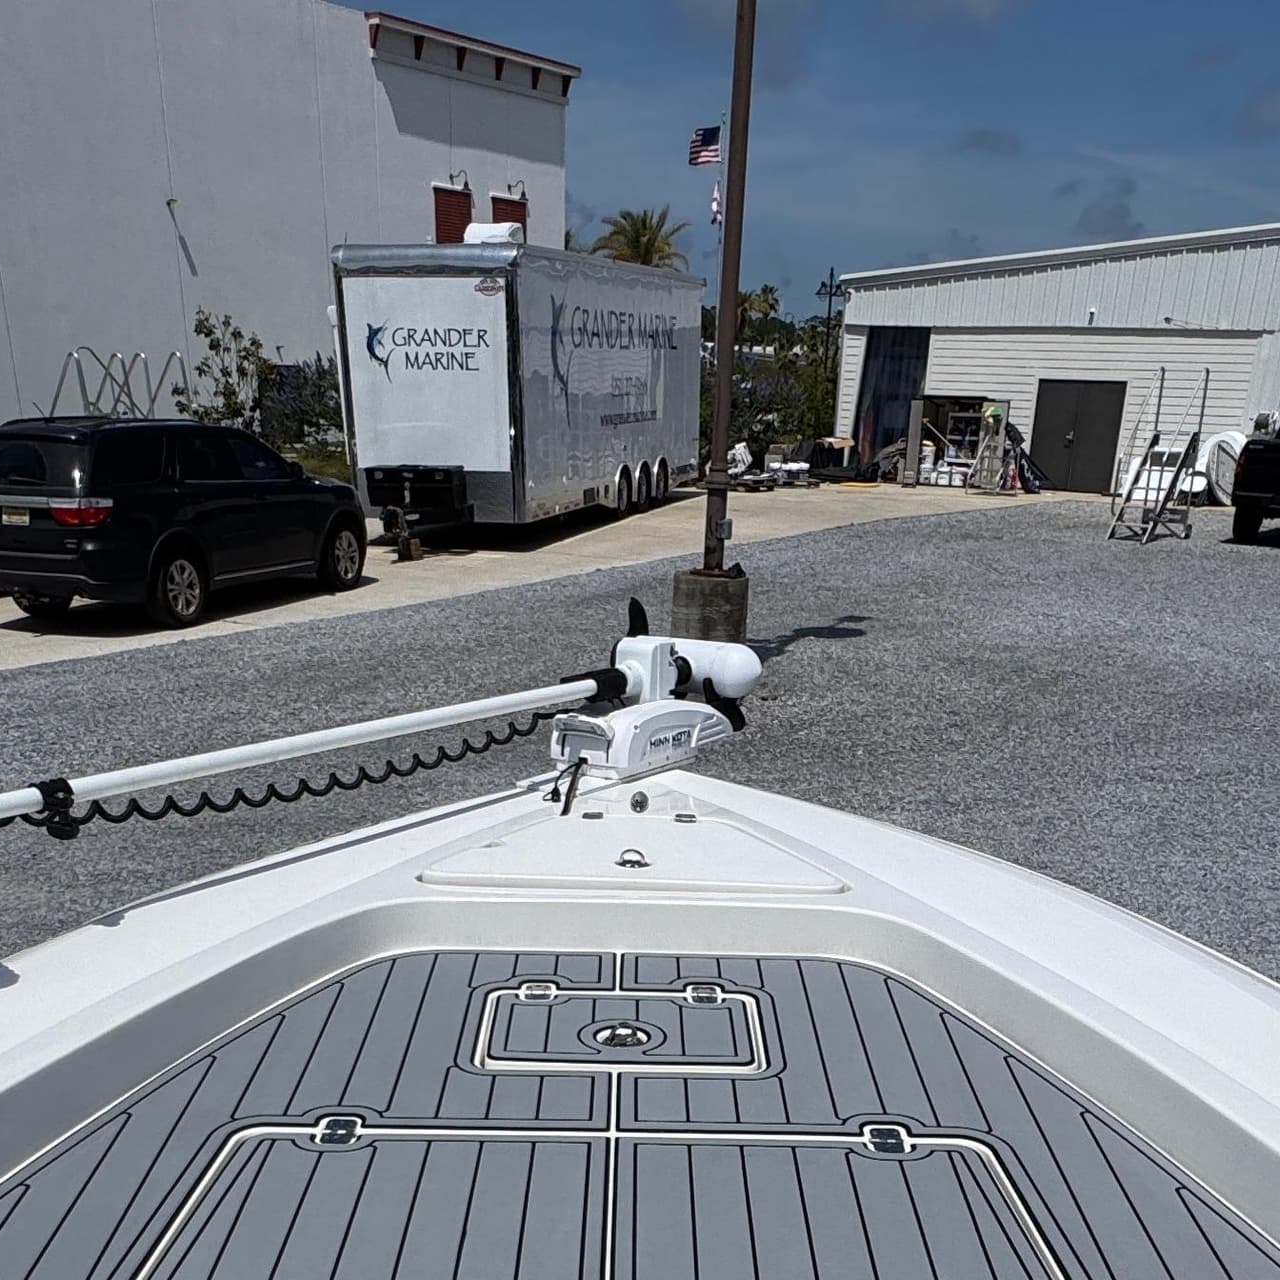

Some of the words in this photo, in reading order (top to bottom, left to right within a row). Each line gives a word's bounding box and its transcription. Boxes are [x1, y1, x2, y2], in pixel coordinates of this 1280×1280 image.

[392, 327, 489, 348] GRANDER
[571, 306, 635, 349] GRANDER
[638, 312, 677, 349] MARINE
[405, 351, 480, 371] MARINE
[650, 737, 670, 749] MINN
[672, 730, 691, 742] KOTA
